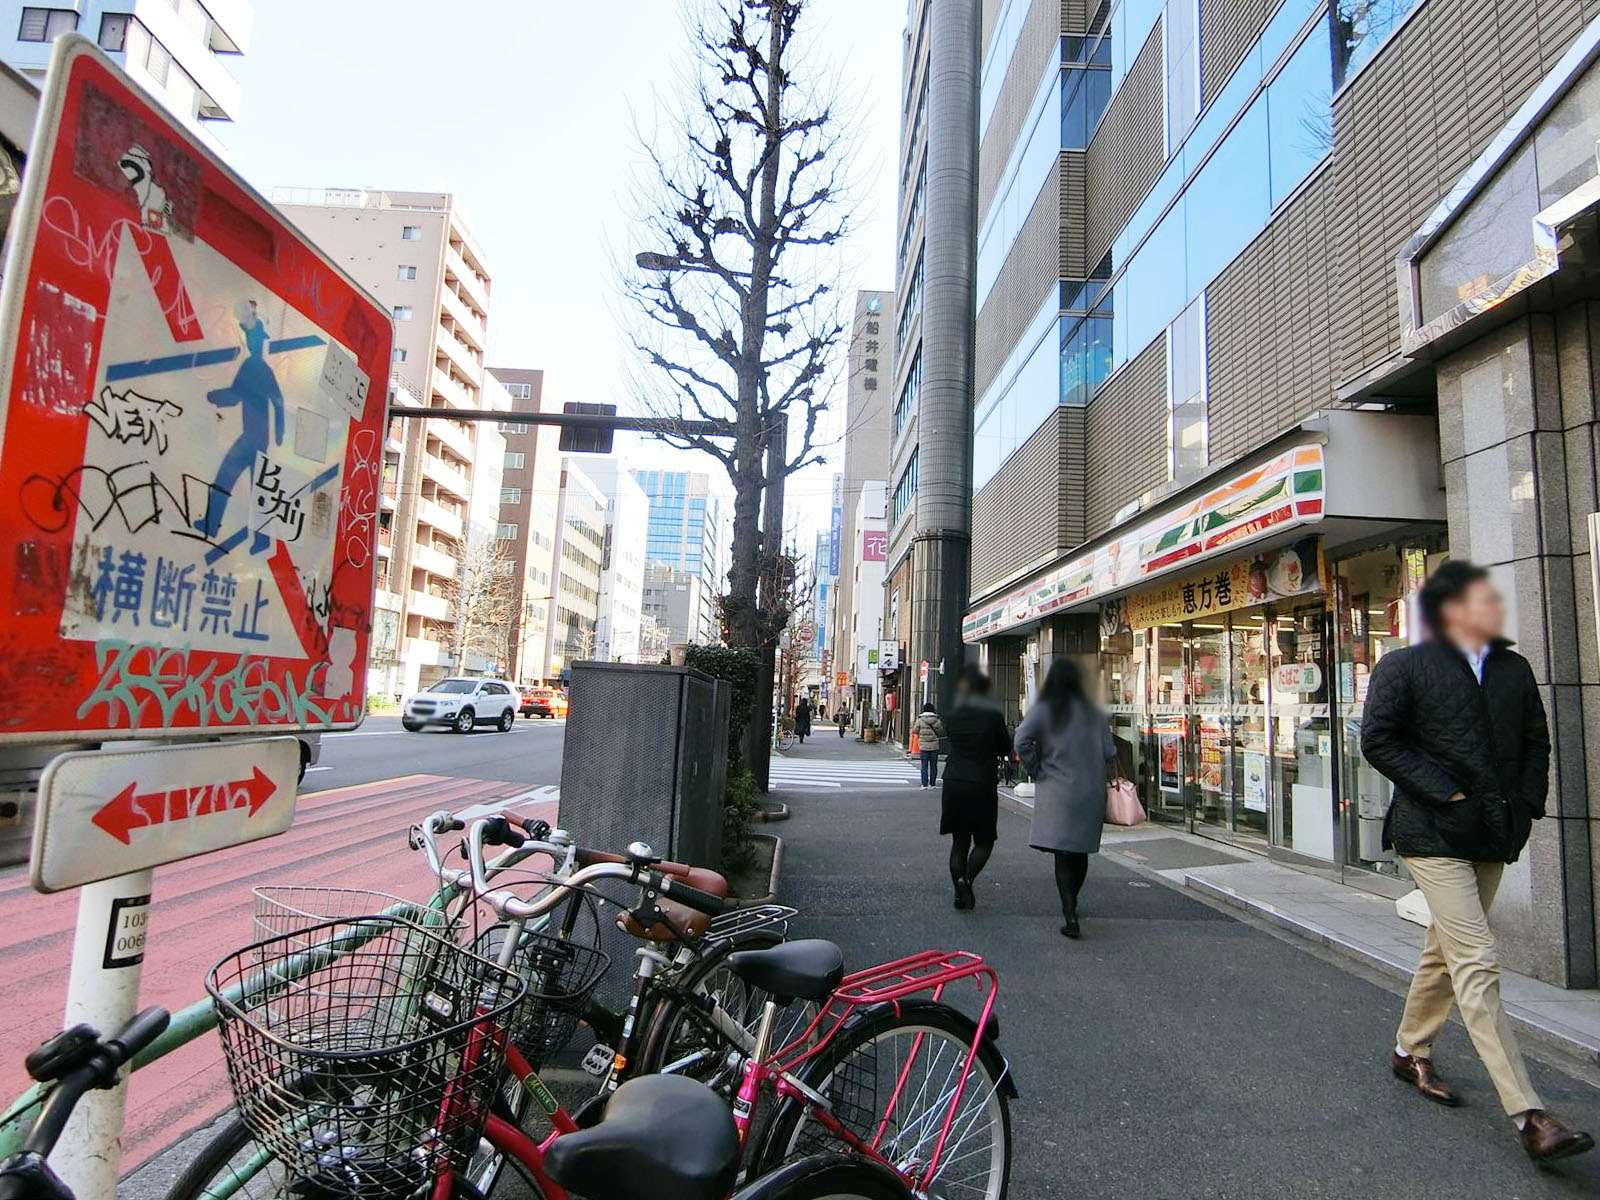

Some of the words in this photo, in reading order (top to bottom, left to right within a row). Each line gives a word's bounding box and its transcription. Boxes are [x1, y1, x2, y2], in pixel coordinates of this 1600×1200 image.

[867, 536, 887, 556] 花
[91, 546, 269, 641] 横断禁止
[1182, 571, 1231, 614] 恵方巻
[1279, 668, 1300, 685] たばこ
[1304, 667, 1314, 684] 酒
